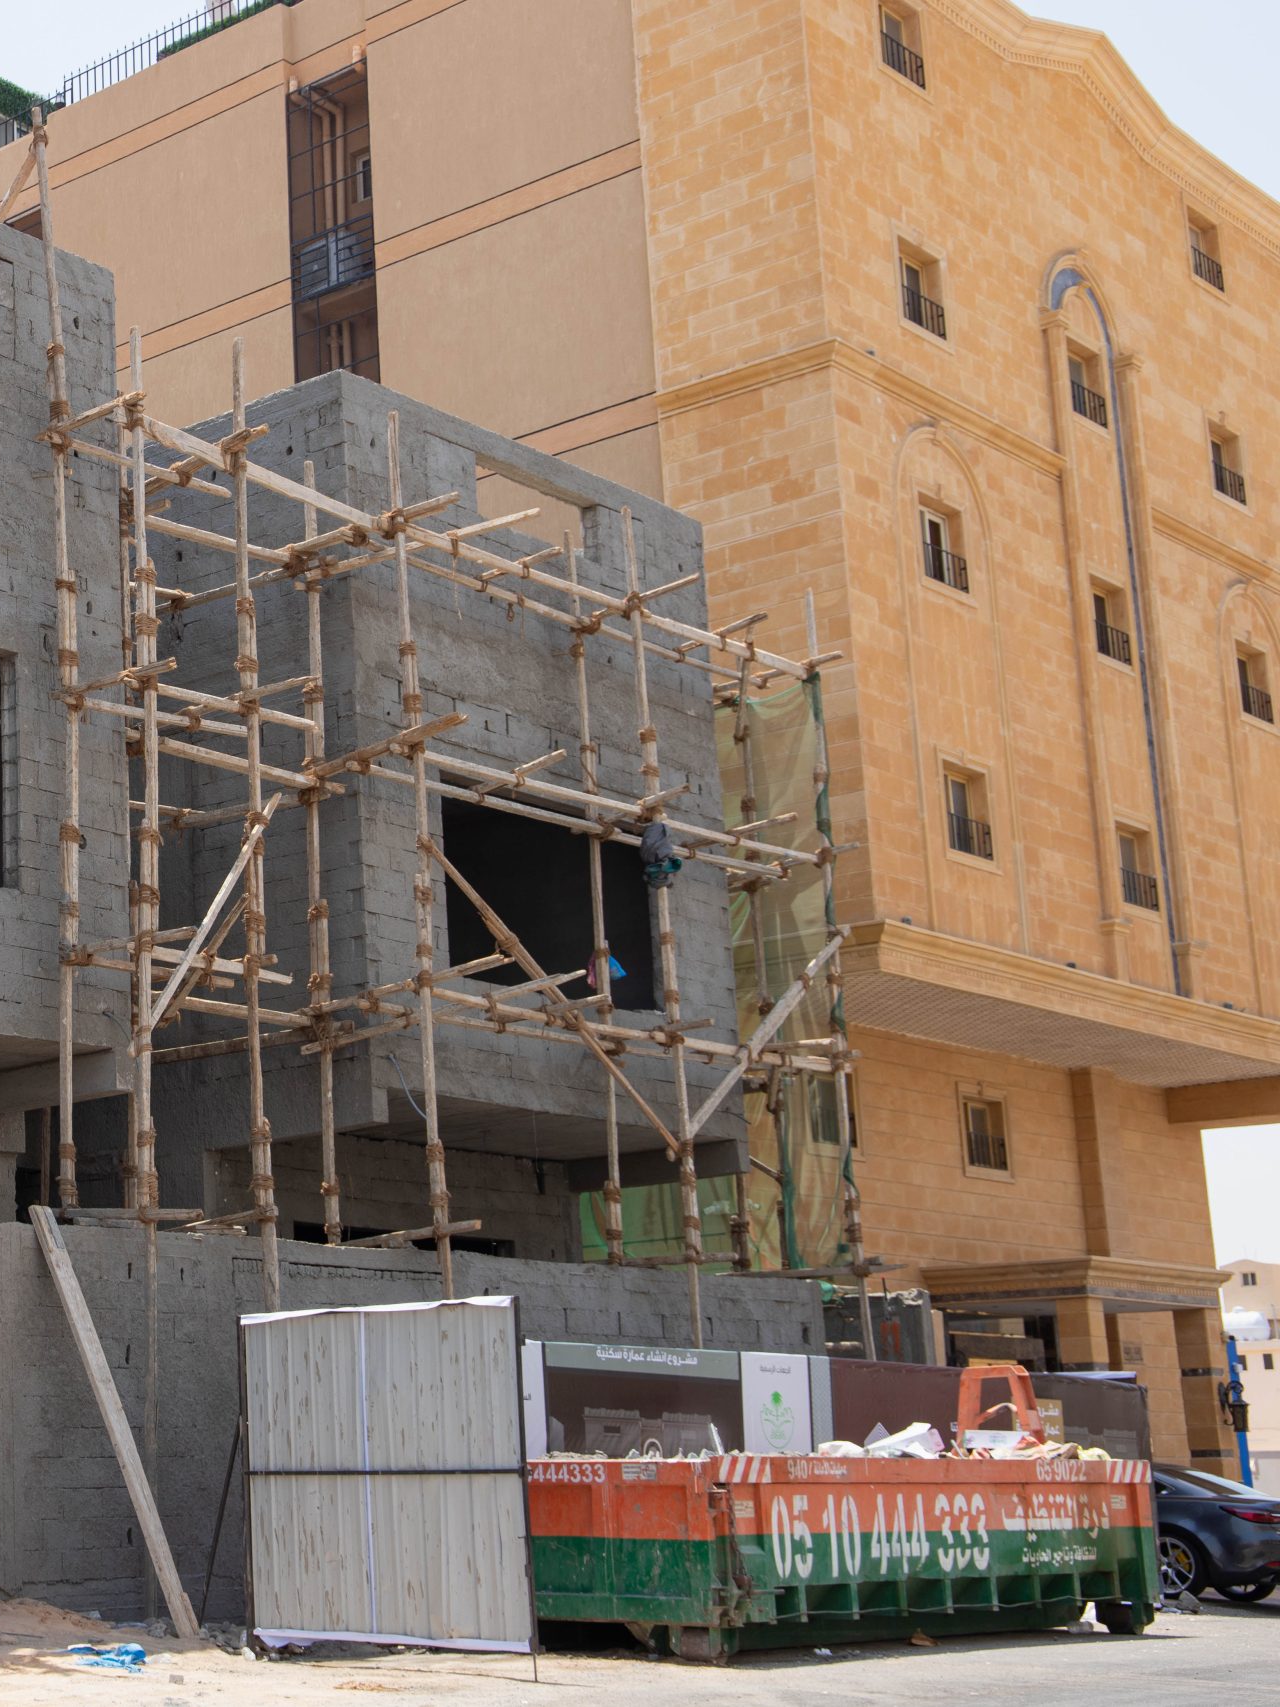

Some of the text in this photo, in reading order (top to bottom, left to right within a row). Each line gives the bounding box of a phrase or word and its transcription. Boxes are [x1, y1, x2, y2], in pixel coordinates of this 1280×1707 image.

[596, 1345, 623, 1361] سكنية
[623, 1347, 645, 1362] عمارة
[666, 1352, 698, 1366] مشروع
[1001, 1493, 1111, 1544] درة التنظيف
[771, 1492, 990, 1579] 05 10 444 333
